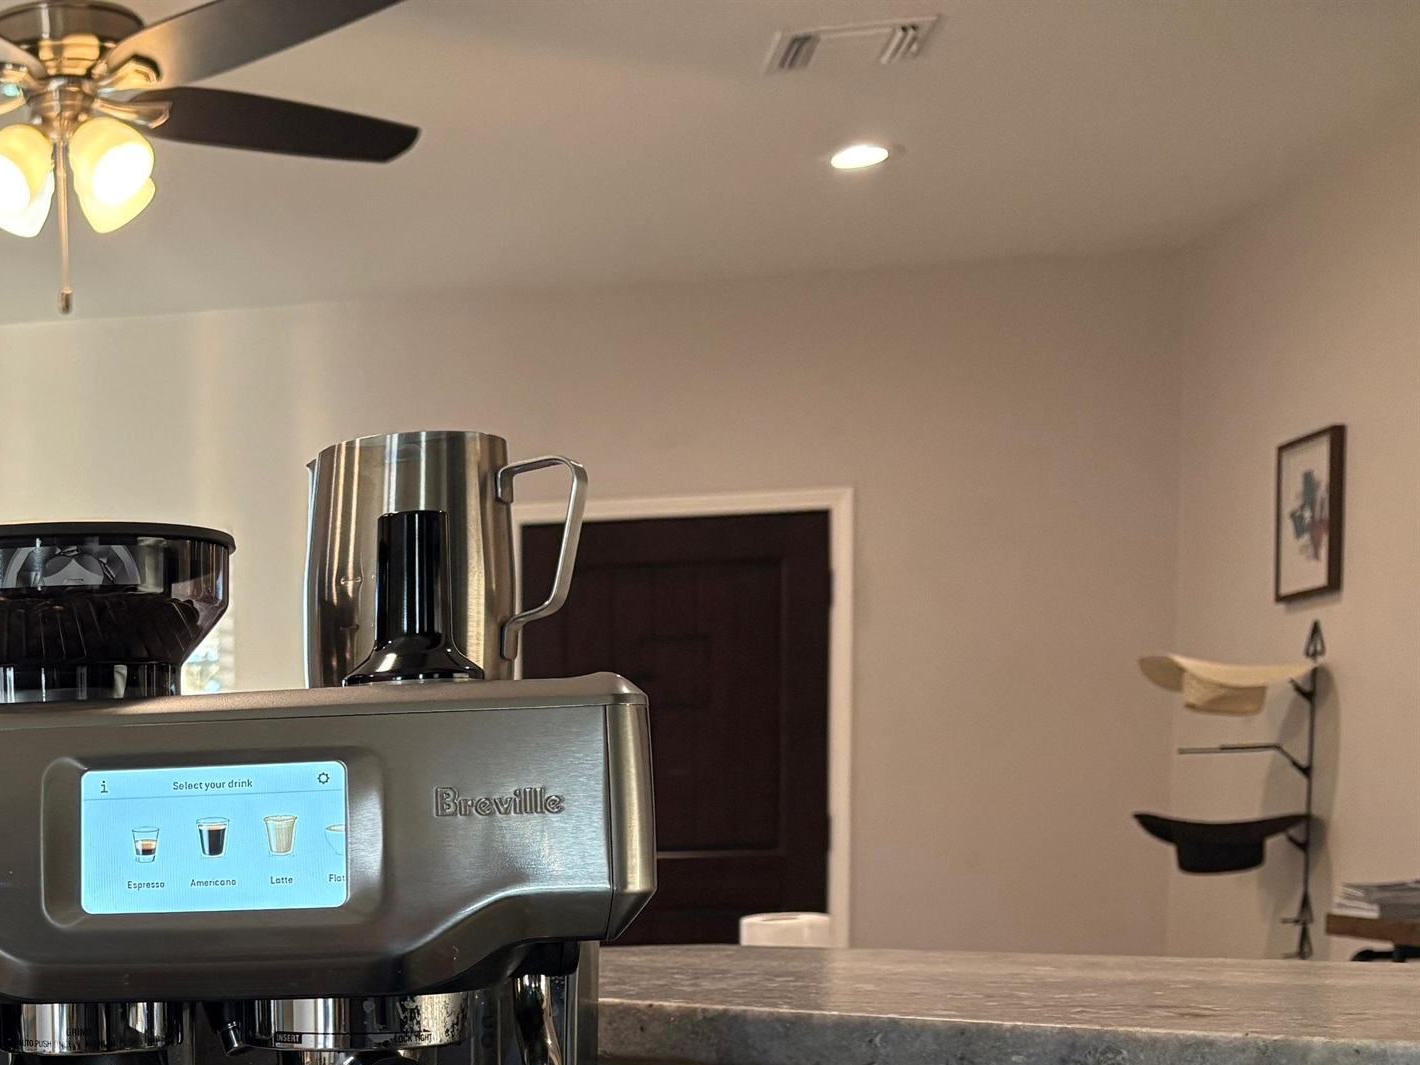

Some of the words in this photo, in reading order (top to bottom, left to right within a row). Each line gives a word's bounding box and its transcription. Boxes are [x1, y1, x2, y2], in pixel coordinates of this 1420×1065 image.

[172, 780, 203, 791] Select
[204, 781, 226, 792] your
[227, 778, 253, 789] drink
[434, 786, 566, 818] Breville
[127, 879, 165, 891] Espresso
[190, 878, 237, 887] Americano
[270, 875, 294, 885] Latte
[66, 1028, 91, 1037] GRIND
[276, 1033, 300, 1043] INSERT
[394, 1033, 413, 1043] LOCK
[414, 1033, 432, 1042] TIGHT
[35, 1039, 52, 1048] PUSH
